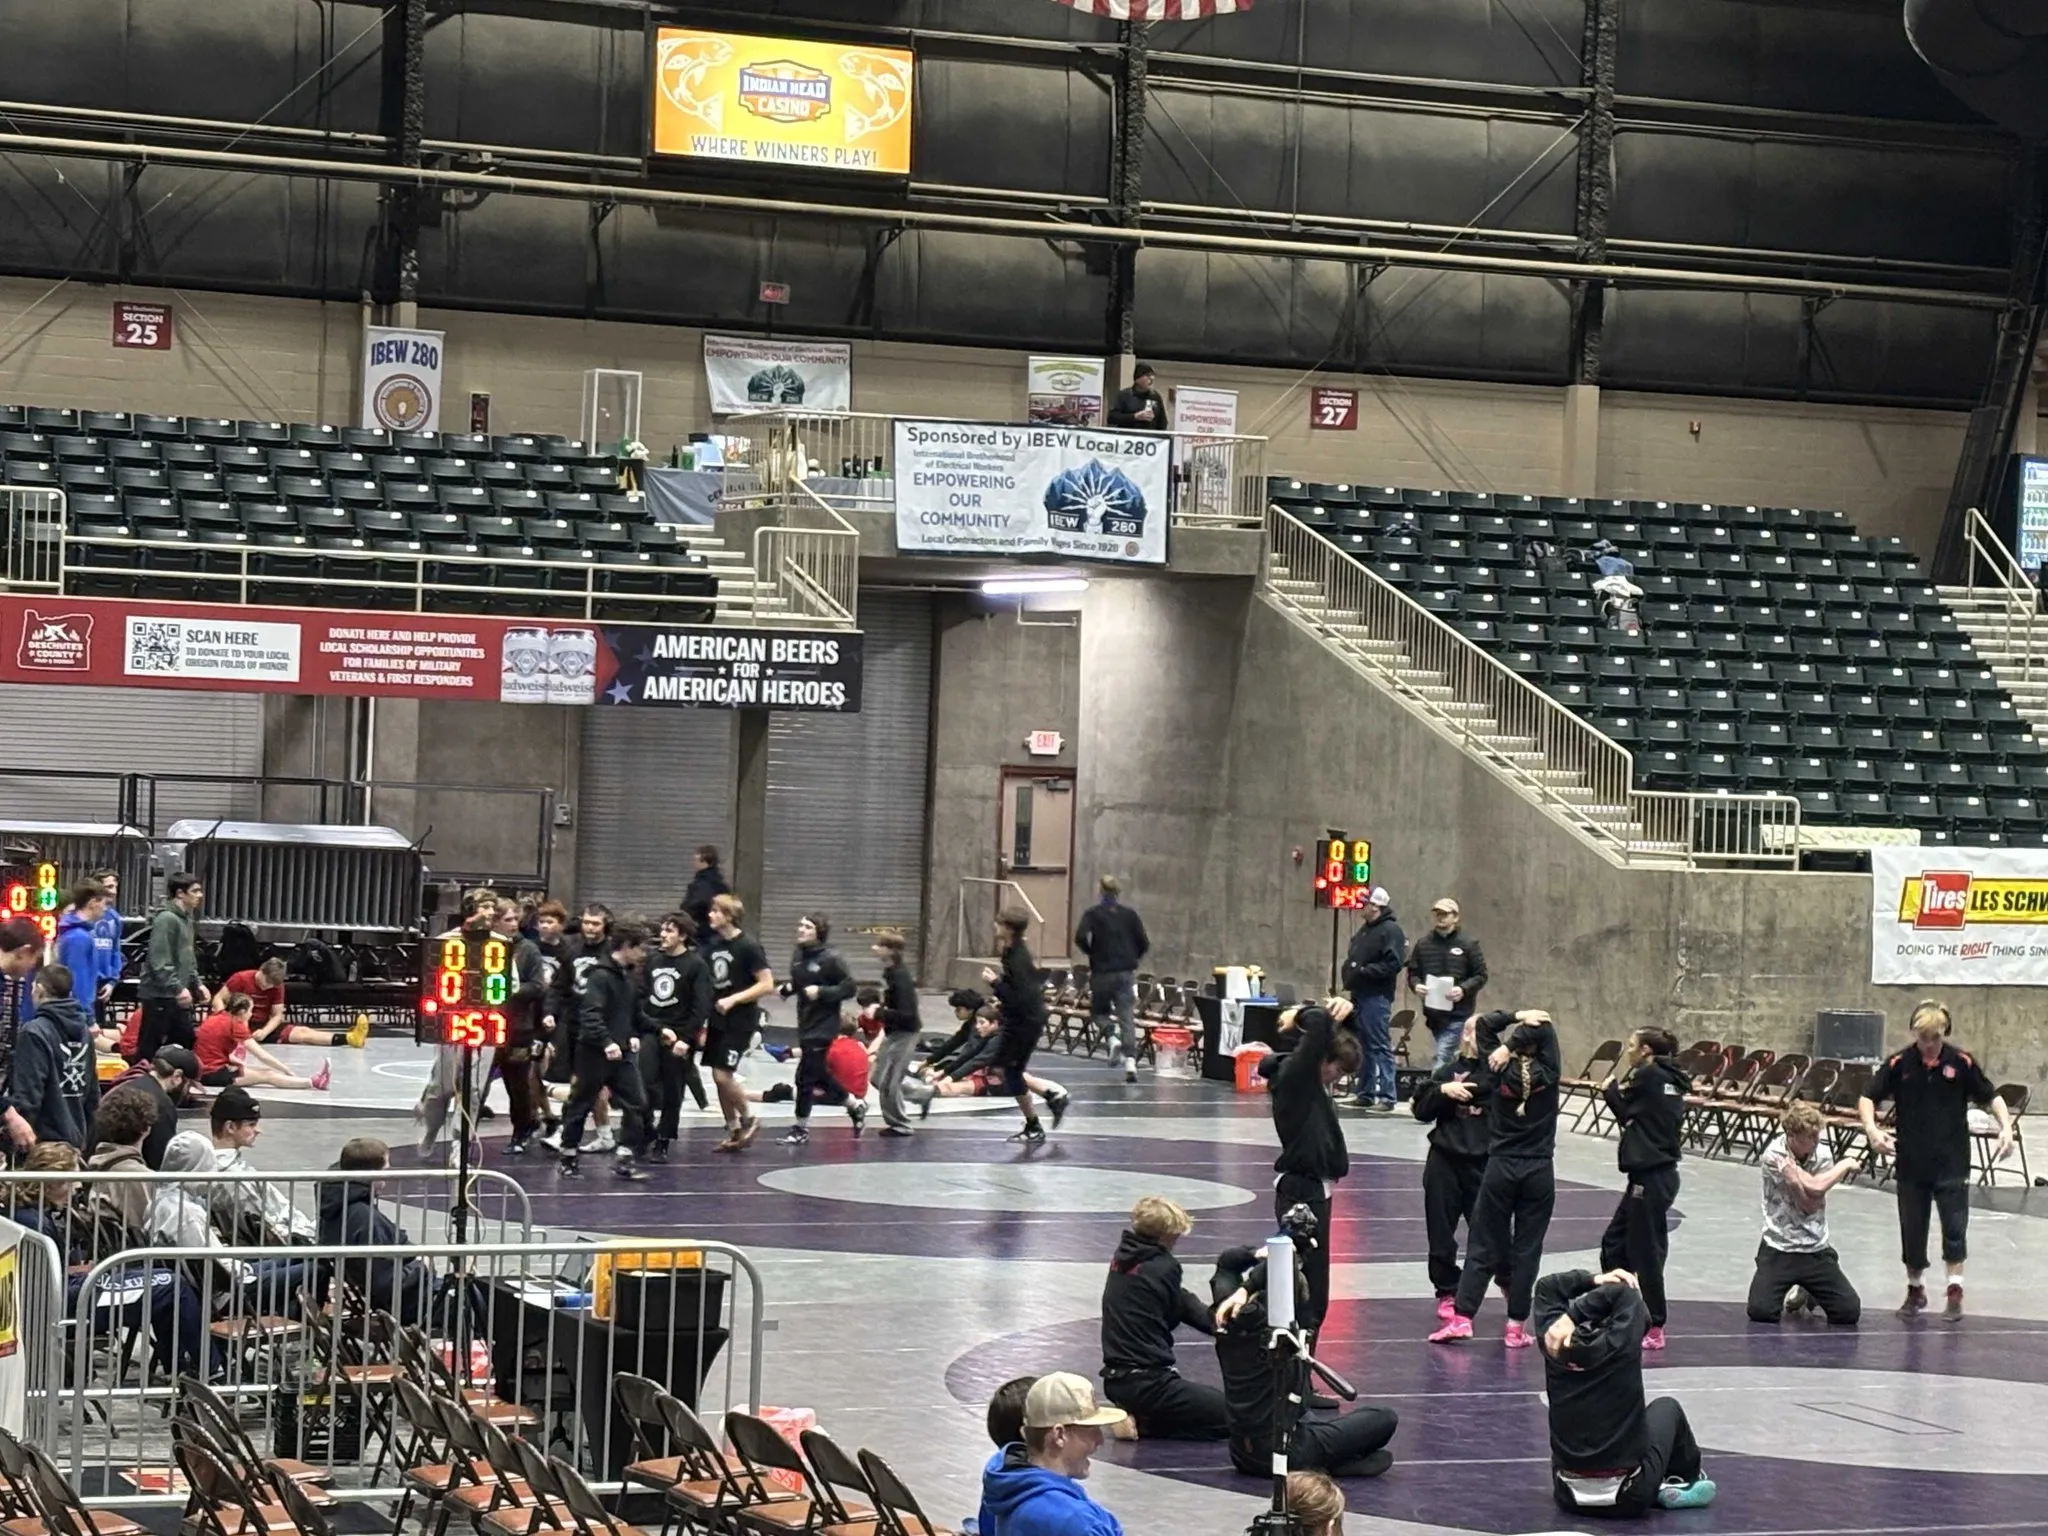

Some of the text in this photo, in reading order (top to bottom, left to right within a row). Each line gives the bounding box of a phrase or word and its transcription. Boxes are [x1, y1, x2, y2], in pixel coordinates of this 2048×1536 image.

[743, 75, 826, 99] INDIAN HEAD
[757, 97, 811, 116] CASINO
[691, 135, 877, 167] WHERE WINNERS PLAY!
[122, 312, 164, 324] SECTION
[126, 323, 158, 345] 25
[370, 340, 438, 370] IBEW 280
[706, 348, 848, 365] EMPOWERING OUR COMMUNITY
[1319, 397, 1352, 407] SECTION
[1321, 406, 1348, 425] 27
[907, 427, 1157, 457] Sponsored by IBEW Local 280
[913, 472, 1015, 489] EMPOWERING
[949, 493, 982, 508] OUR
[920, 511, 1011, 529] COMMUNITY
[1050, 514, 1137, 534] IBEW 280
[921, 534, 945, 544] Local
[947, 535, 997, 546] Contractors
[999, 537, 1015, 546] and
[1017, 537, 1049, 547] Family
[1072, 540, 1096, 551] Since
[28, 641, 83, 650] DESCHUTES
[186, 629, 259, 646] SCAN HERE
[329, 628, 476, 644] DONATE HERE AND HELP PROVIDE
[36, 650, 75, 659] COUNTY
[186, 647, 290, 660] TO DONATE TO YOUR LOCAL
[320, 642, 485, 659] LOCAL SCHOLARSHIP OPPORTUNITIES
[652, 634, 840, 664] AMERICAN BEERS
[247, 661, 257, 669] OF
[343, 657, 462, 672] FOR FAMILIES OF MILITARY
[733, 663, 760, 678] FOR
[329, 671, 474, 686] VETERANS & FIRST RESPONDERS
[642, 676, 846, 705] AMERICAN HEROES
[1037, 734, 1055, 747] EXIT
[1331, 840, 1345, 862] 0
[1354, 841, 1369, 862] 0
[40, 863, 56, 888] 0
[1328, 861, 1343, 882] 0
[1356, 862, 1369, 883] 0
[11, 886, 27, 911] 0
[41, 887, 57, 911] 0
[1922, 880, 1967, 914] Tires
[1970, 890, 1999, 911] LES
[444, 939, 466, 971] 0
[484, 941, 506, 973] 0
[1896, 941, 2048, 957] DOING THE RIGHT THING SIN
[441, 971, 462, 1004] 0
[486, 973, 506, 1005] 0
